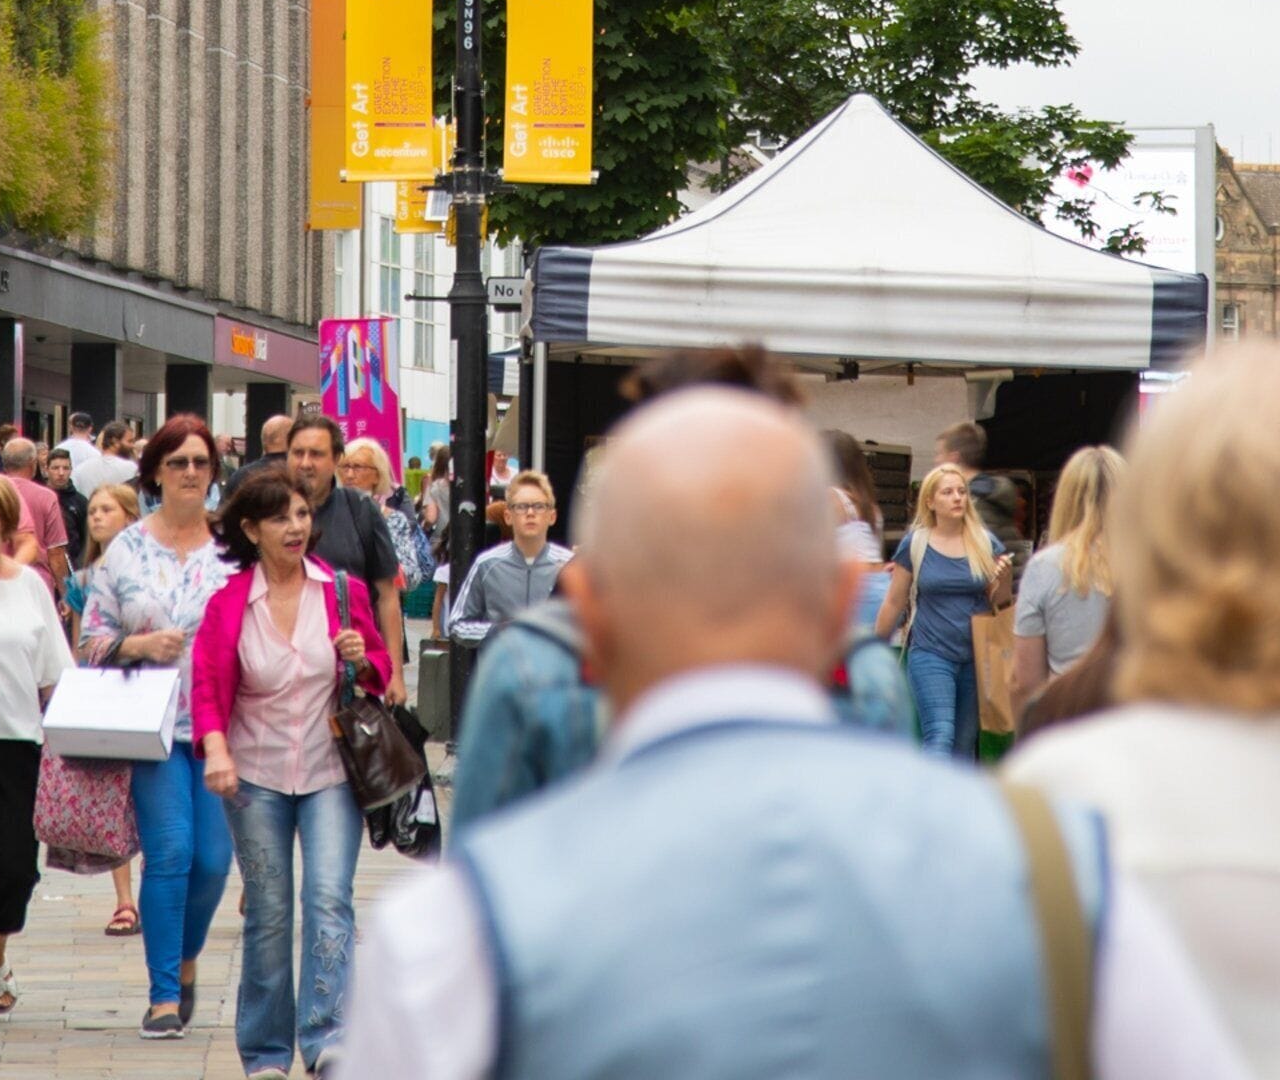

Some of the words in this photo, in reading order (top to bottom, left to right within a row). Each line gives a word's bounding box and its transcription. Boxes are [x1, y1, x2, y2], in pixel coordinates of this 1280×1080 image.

[351, 82, 369, 115] Art
[511, 83, 528, 117] Art
[351, 121, 369, 158] Get
[373, 147, 428, 159] accenture
[509, 122, 527, 157] Get
[494, 284, 514, 297] No
